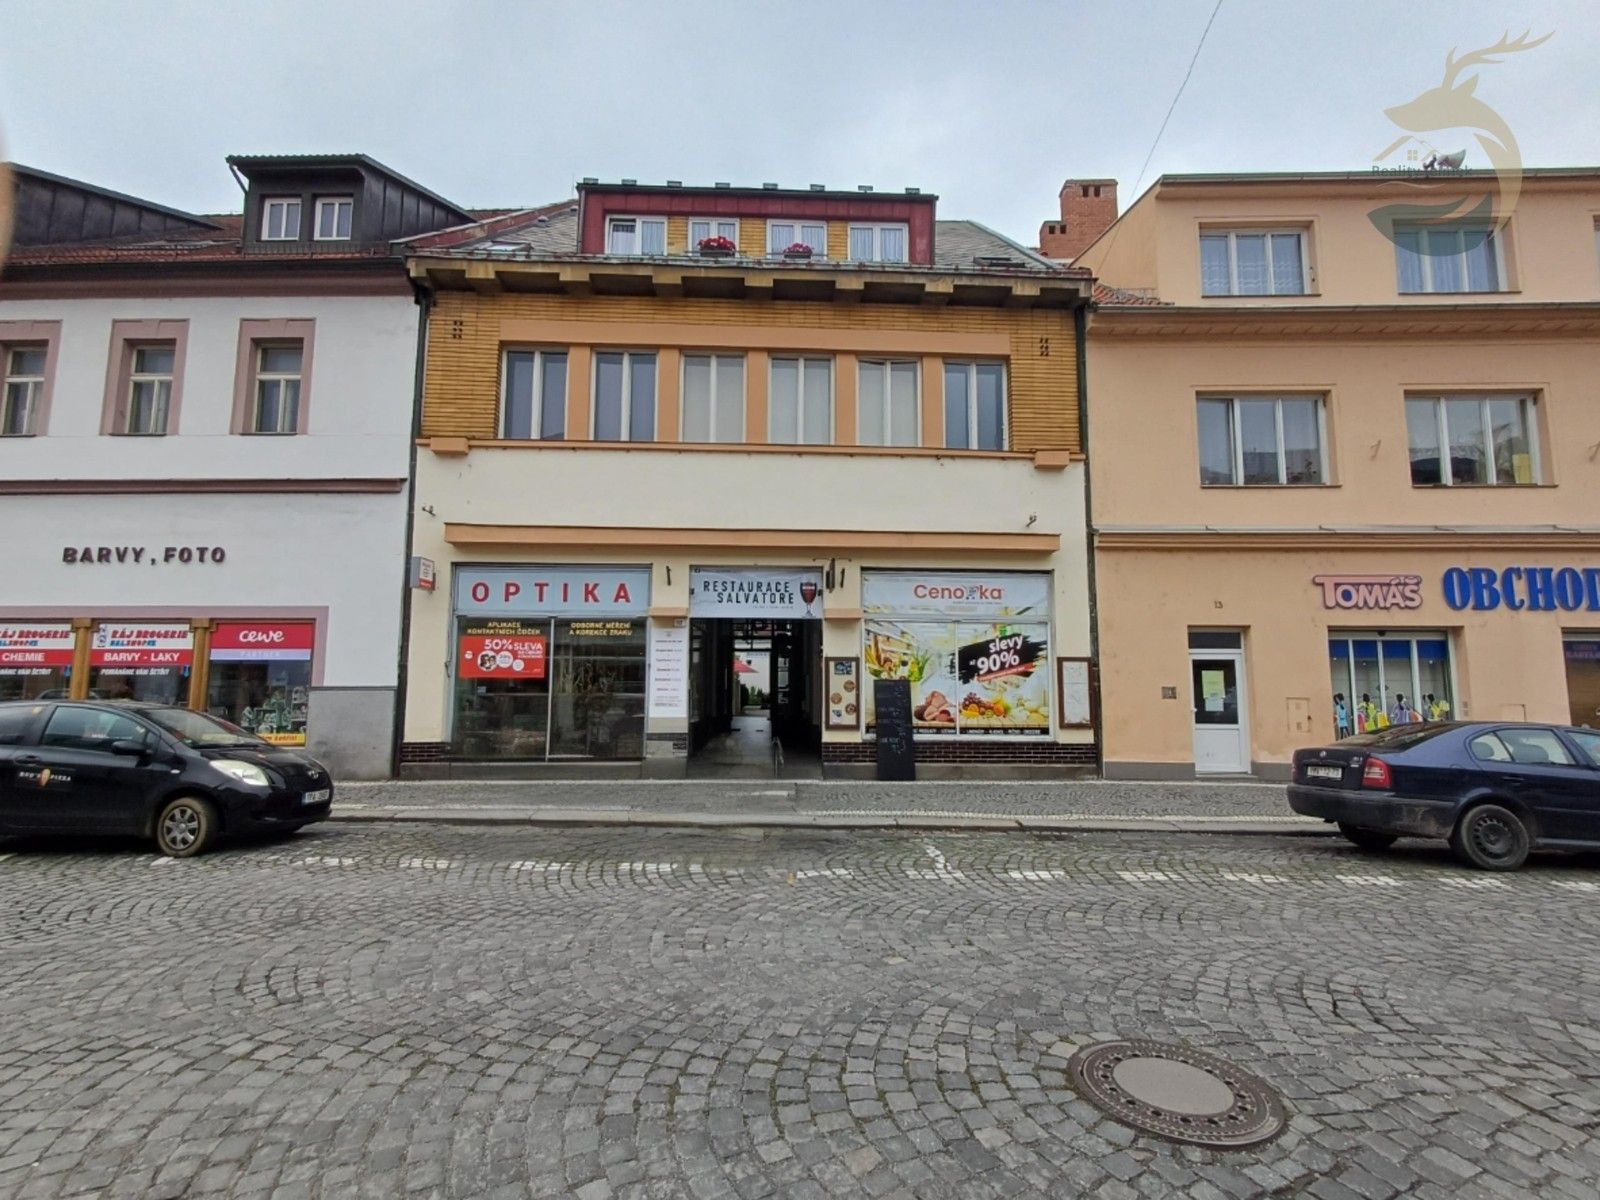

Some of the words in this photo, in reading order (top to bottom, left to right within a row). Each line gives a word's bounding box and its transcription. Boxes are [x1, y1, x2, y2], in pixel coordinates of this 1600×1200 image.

[163, 547, 226, 563] FOTO
[703, 580, 790, 592] RESTAURACE
[1312, 575, 1423, 609] TOMÁŠ
[472, 582, 631, 603] OPTIKA
[717, 592, 795, 604] SALVATORE
[17, 629, 70, 639] DROGERIE
[111, 627, 134, 638] RÁJ
[135, 629, 188, 639] DROGERIE
[239, 630, 284, 643] cewe
[484, 639, 514, 650] 50%
[513, 642, 543, 651] SLEVA
[988, 635, 1023, 653] slevy
[2, 652, 46, 661] CHEMIE
[104, 652, 140, 661] BARVY
[150, 652, 180, 661] LAKY
[976, 649, 1020, 675] 90%
